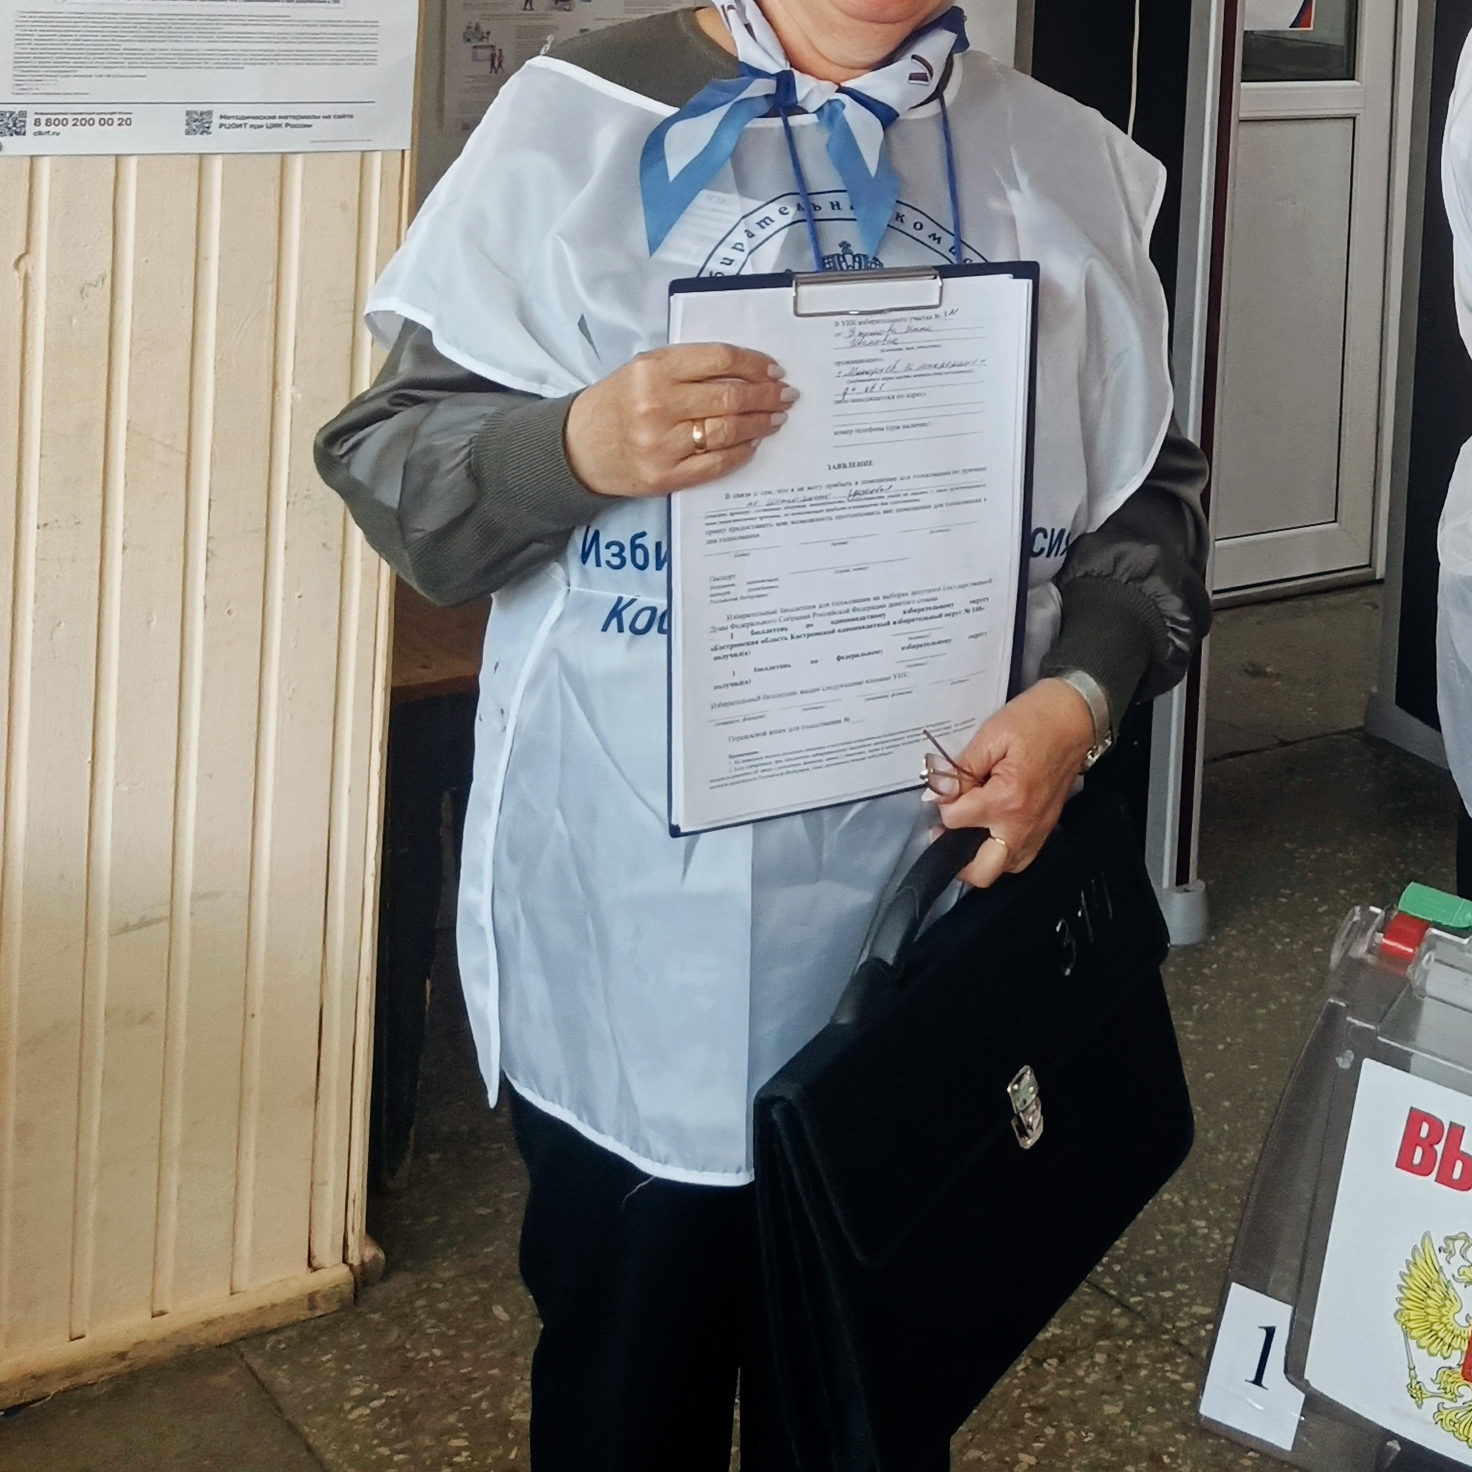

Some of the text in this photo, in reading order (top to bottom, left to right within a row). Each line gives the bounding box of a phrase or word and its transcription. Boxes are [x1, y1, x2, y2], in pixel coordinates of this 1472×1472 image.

[33, 117, 132, 127] 8 800 200 00 20
[827, 459, 873, 470] ЗАЯВЛЕНИЕ
[1244, 1325, 1277, 1391] 1
